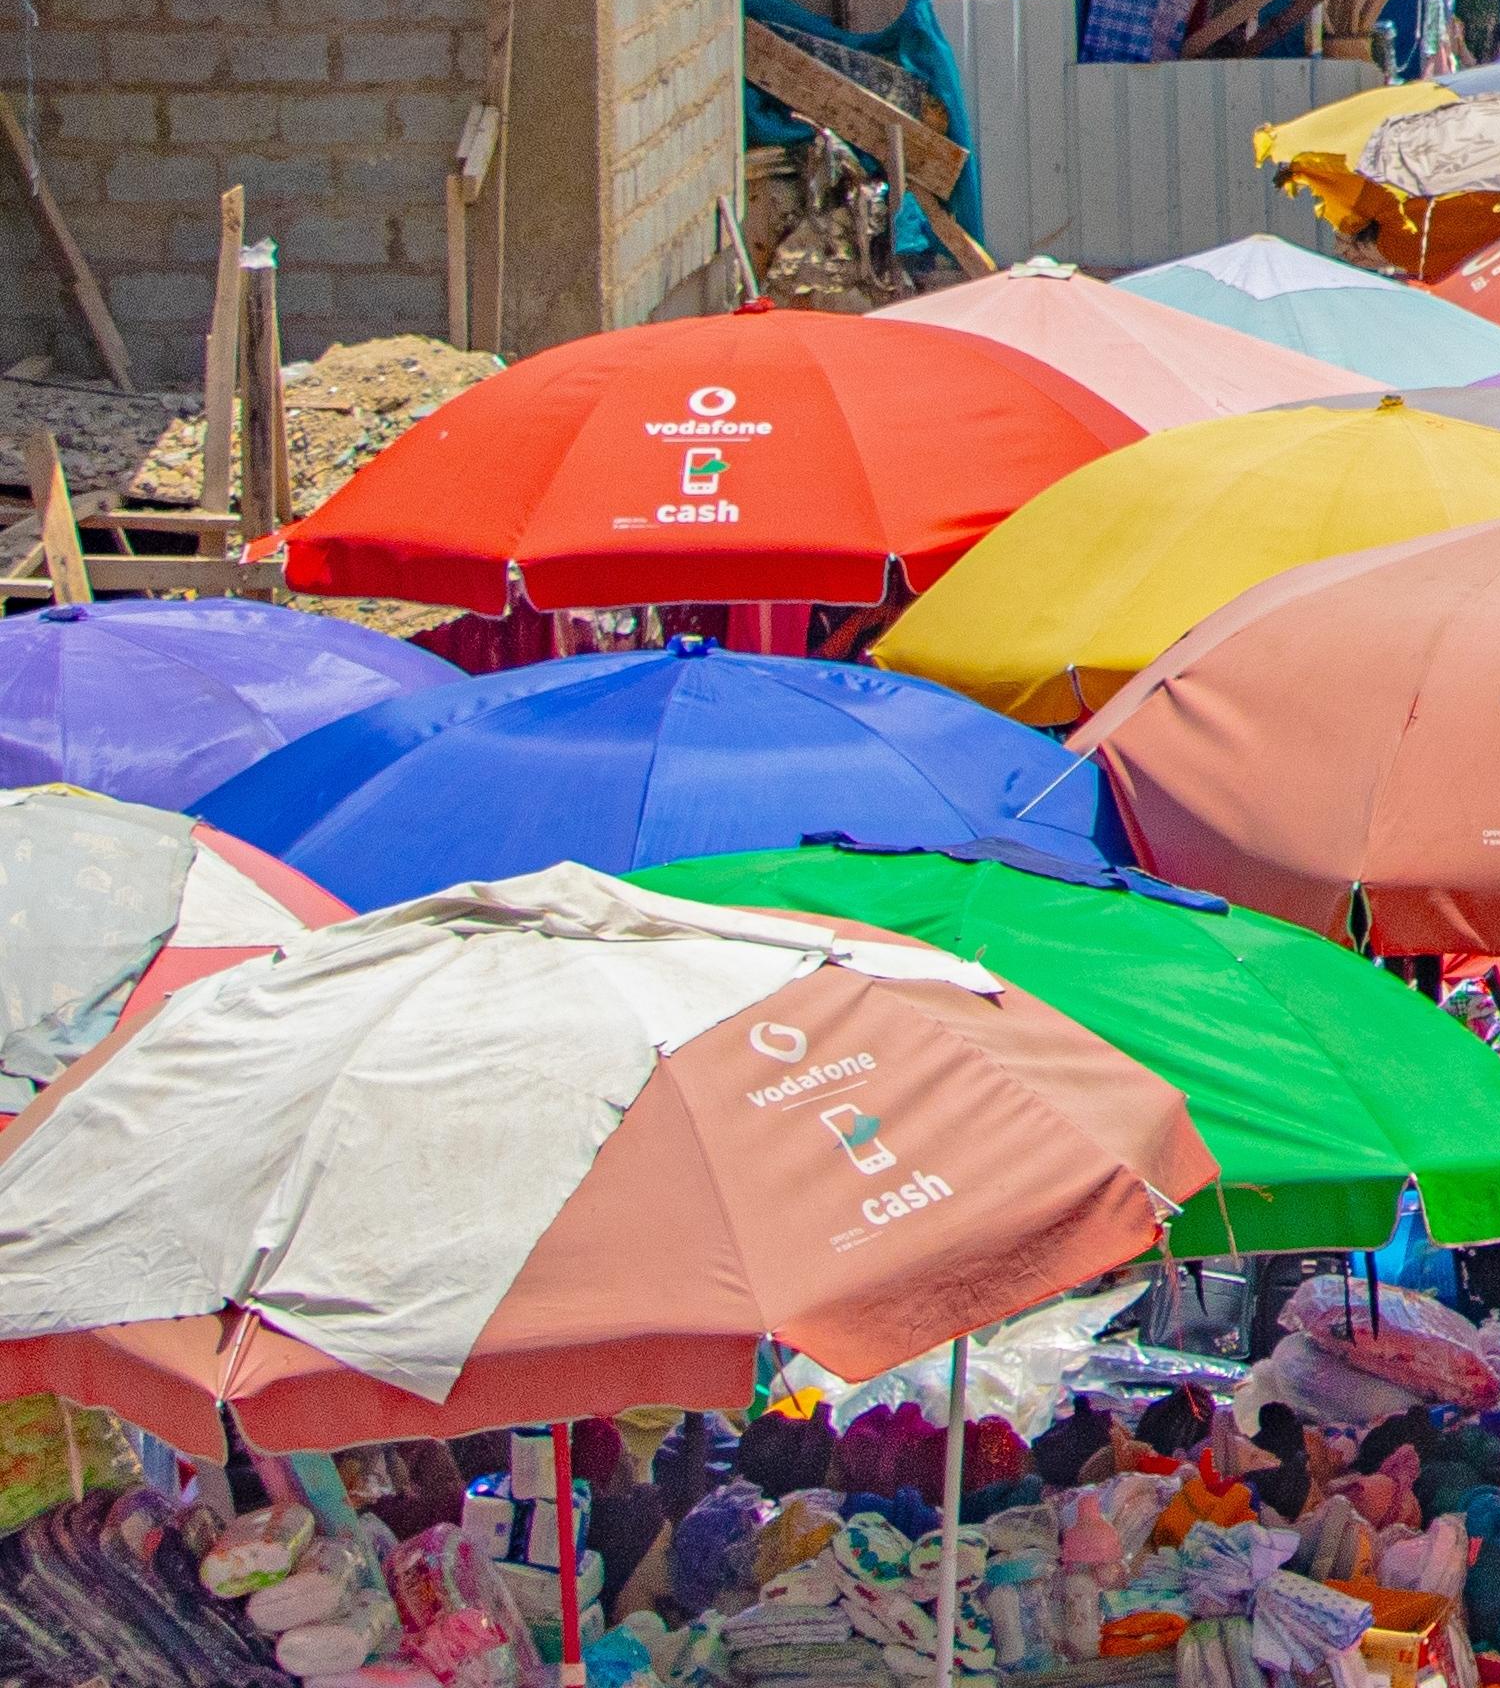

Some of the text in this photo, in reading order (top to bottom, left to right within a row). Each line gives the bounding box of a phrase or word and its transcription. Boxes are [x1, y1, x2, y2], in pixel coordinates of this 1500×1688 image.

[644, 419, 773, 435] vodafone
[656, 499, 740, 523] cash
[746, 1051, 877, 1108] vodafone
[861, 1169, 955, 1225] cash
